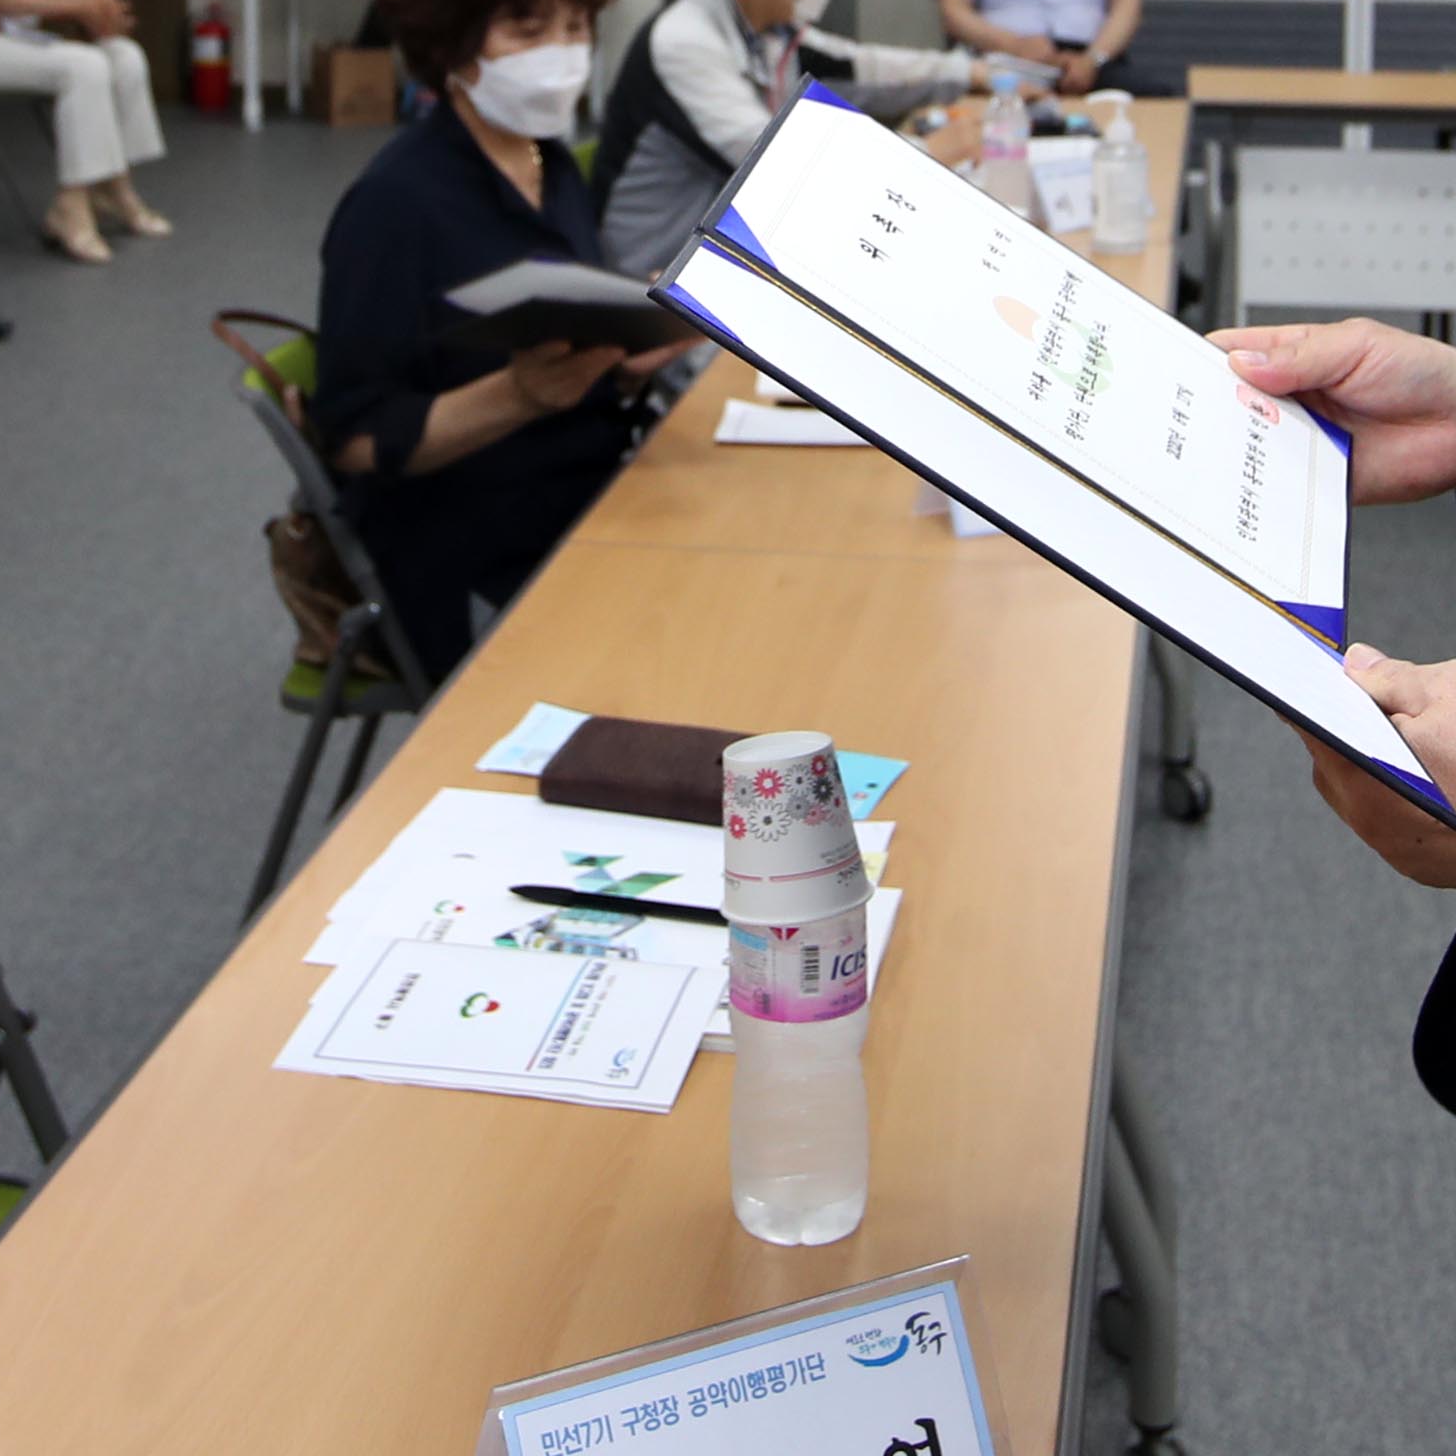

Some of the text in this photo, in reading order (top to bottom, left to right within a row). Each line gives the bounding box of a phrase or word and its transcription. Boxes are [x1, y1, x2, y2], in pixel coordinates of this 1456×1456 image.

[905, 1312, 947, 1356] 동구
[541, 1352, 827, 1456] 민선7기 구청장 공약이행평가단
